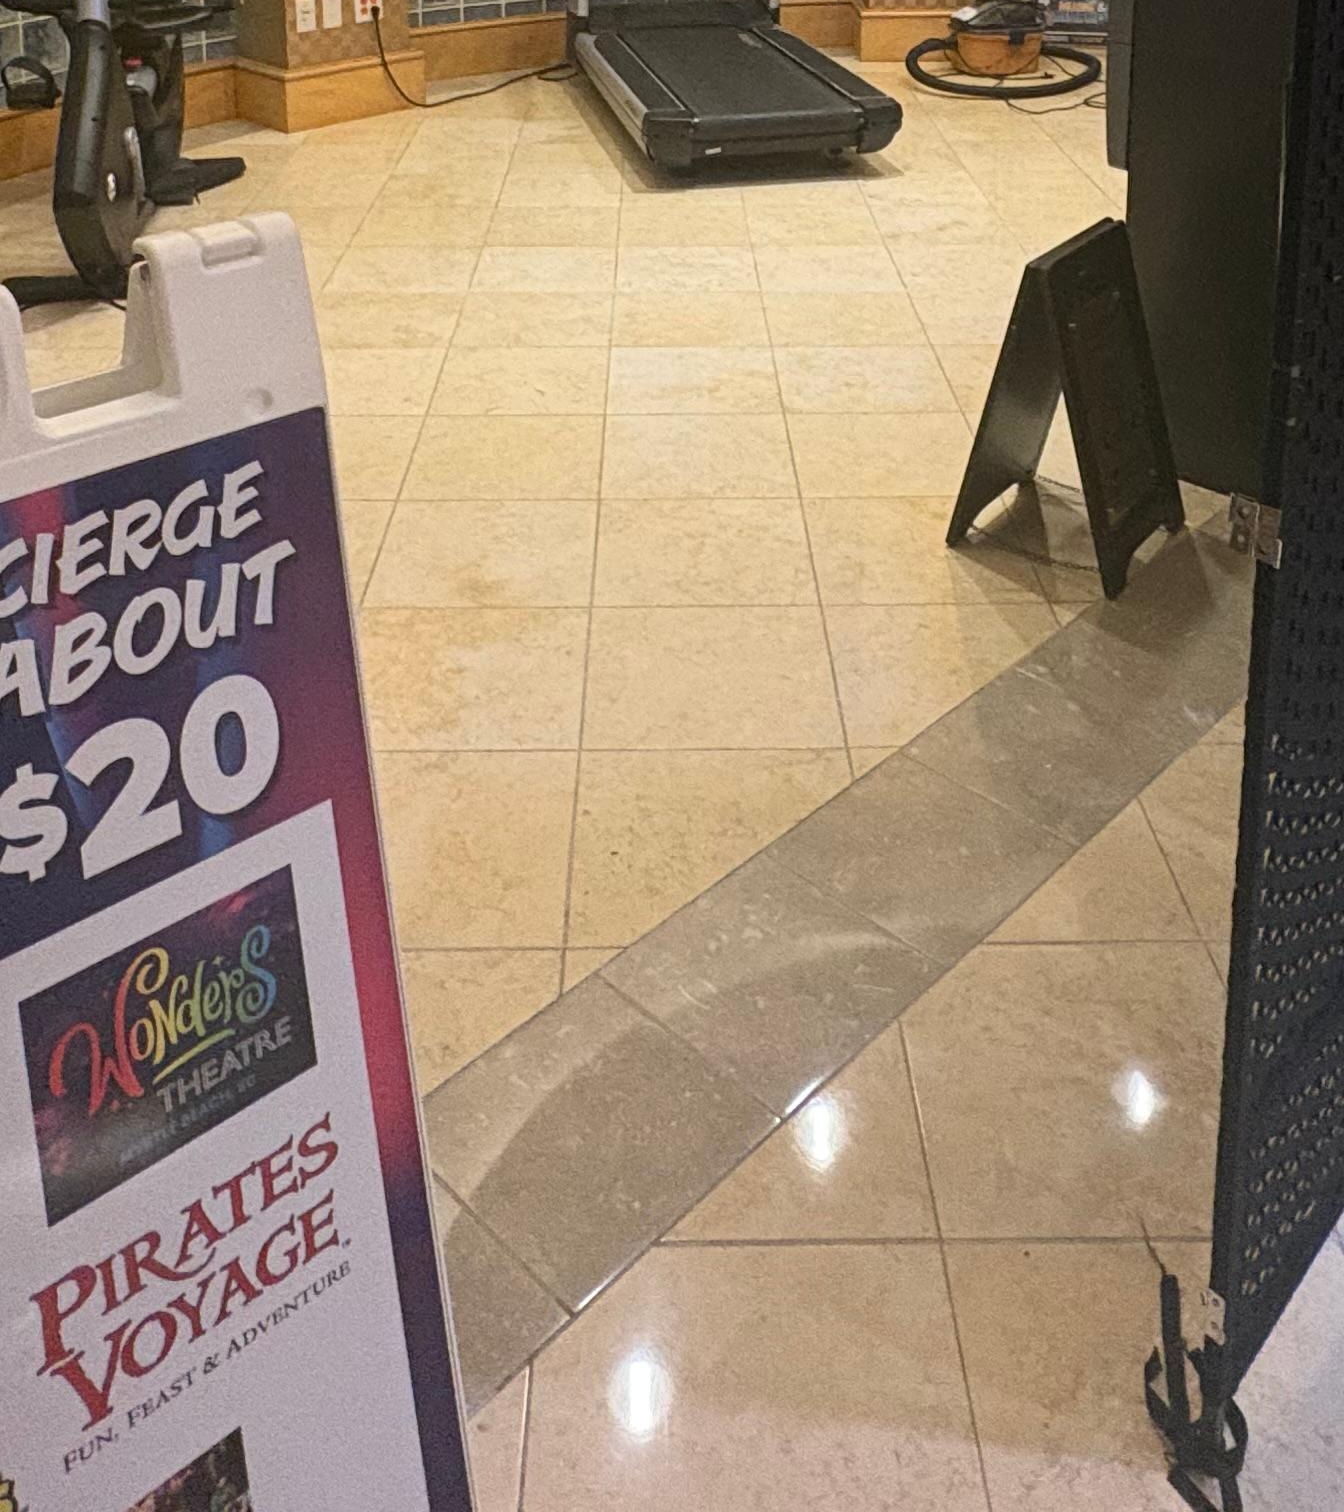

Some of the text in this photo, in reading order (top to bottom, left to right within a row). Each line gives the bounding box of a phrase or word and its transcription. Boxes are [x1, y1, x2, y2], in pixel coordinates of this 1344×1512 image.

[156, 1014, 295, 1114] THEATRE
[29, 1111, 340, 1377] PIRATES
[49, 1188, 341, 1432] VOYAGE
[62, 1259, 352, 1473] FUN, FEAST & ADVENTURE
